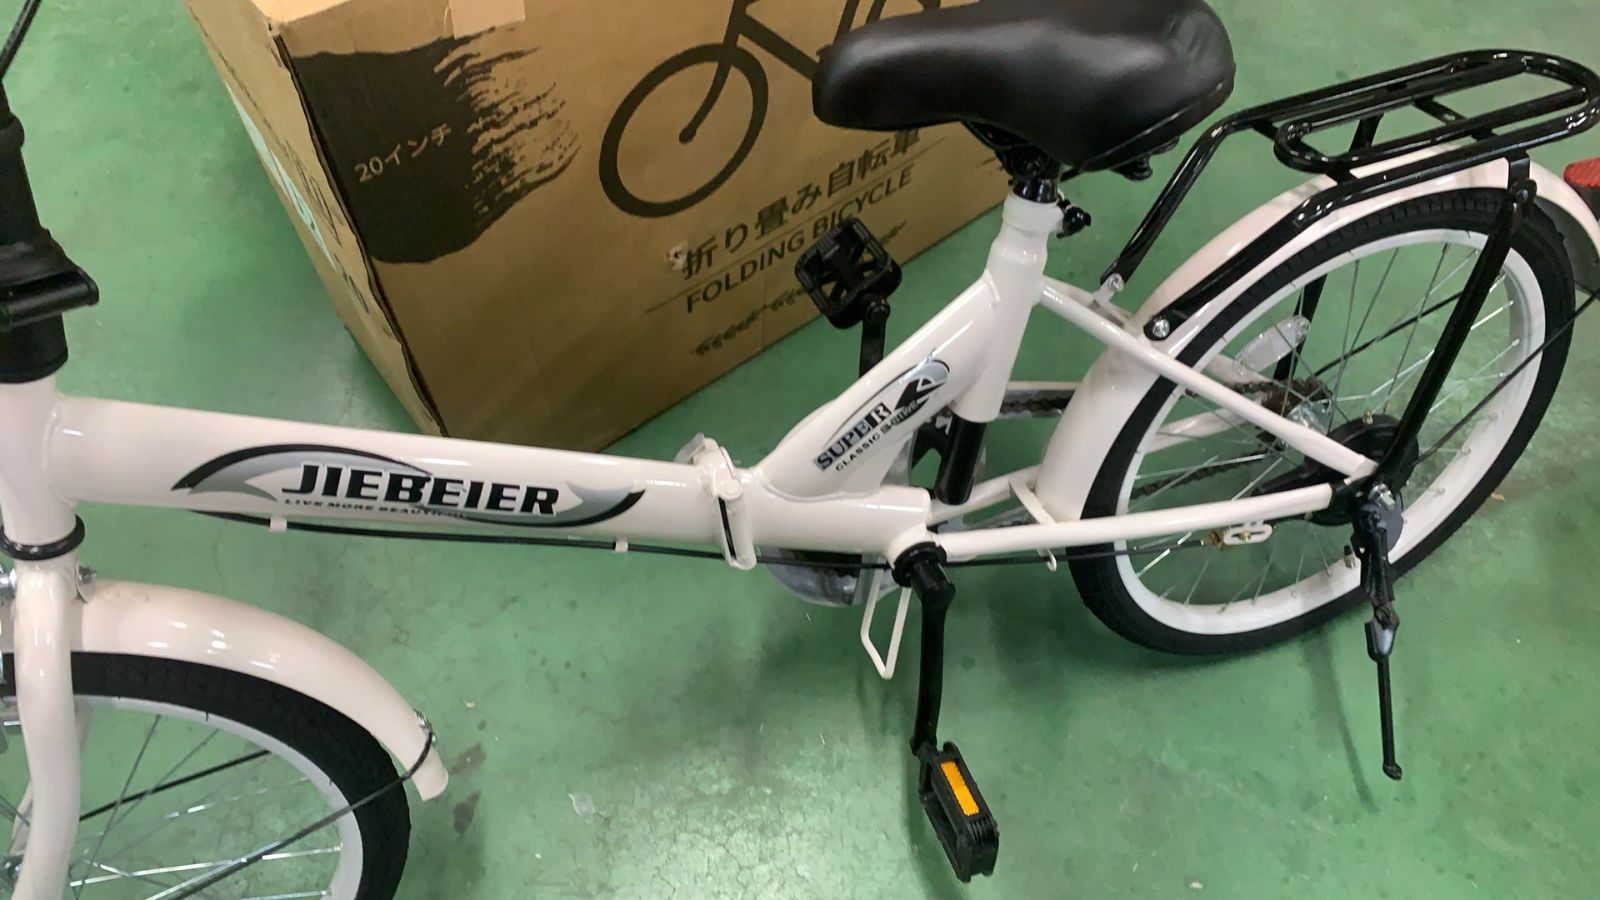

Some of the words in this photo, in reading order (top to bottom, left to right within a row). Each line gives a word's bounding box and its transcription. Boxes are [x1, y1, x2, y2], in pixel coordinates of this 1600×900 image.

[354, 123, 452, 182] 20インチ
[687, 229, 804, 314] FOLDING
[813, 163, 914, 240] BICYCLE
[814, 402, 892, 472] SUPER
[835, 432, 880, 472] CLASSIC
[282, 464, 559, 514] JIEBEIER
[285, 498, 322, 508] LIVE
[328, 502, 374, 512] MORE
